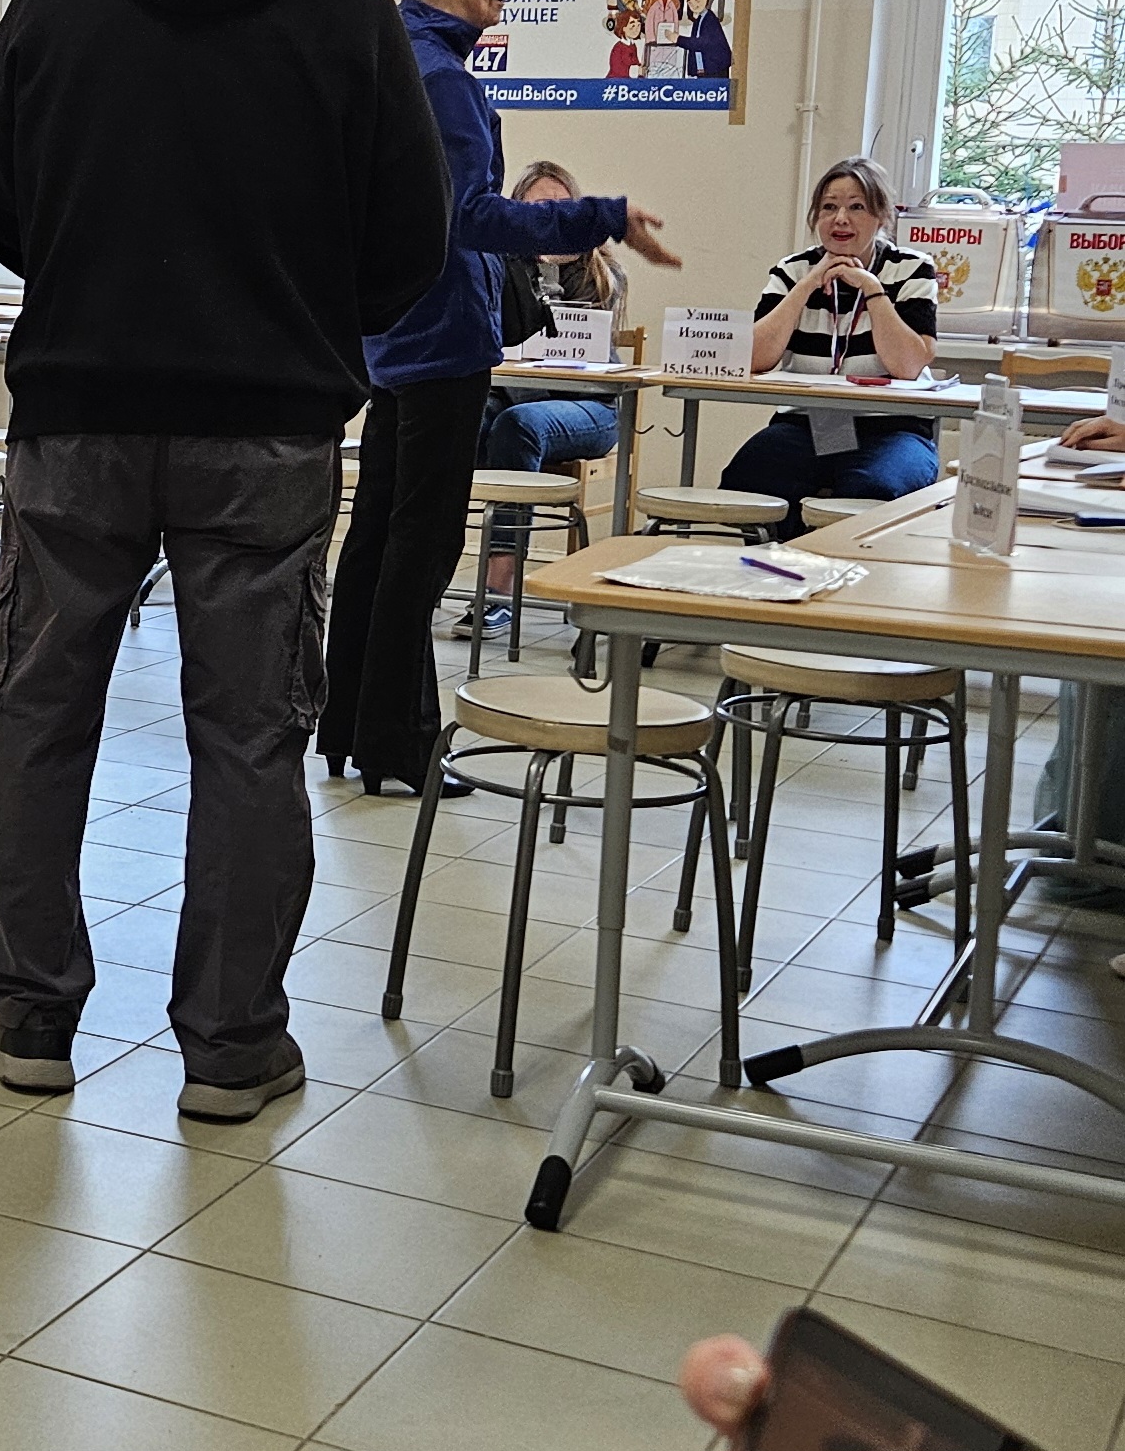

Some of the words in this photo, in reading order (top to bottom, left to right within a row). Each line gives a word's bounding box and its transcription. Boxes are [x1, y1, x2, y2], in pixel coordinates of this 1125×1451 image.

[499, 8, 559, 25] ДУЩЕЕ
[474, 46, 506, 71] 47
[484, 84, 578, 105] НашВыбор
[602, 84, 728, 102] #ВсейСемьей
[909, 226, 983, 246] ВЫБОРЫ
[554, 309, 588, 322] лица
[686, 308, 729, 322] Улица
[678, 326, 734, 340] Изотова
[542, 348, 567, 358] дом
[572, 347, 586, 359] 19
[690, 349, 717, 359] дом
